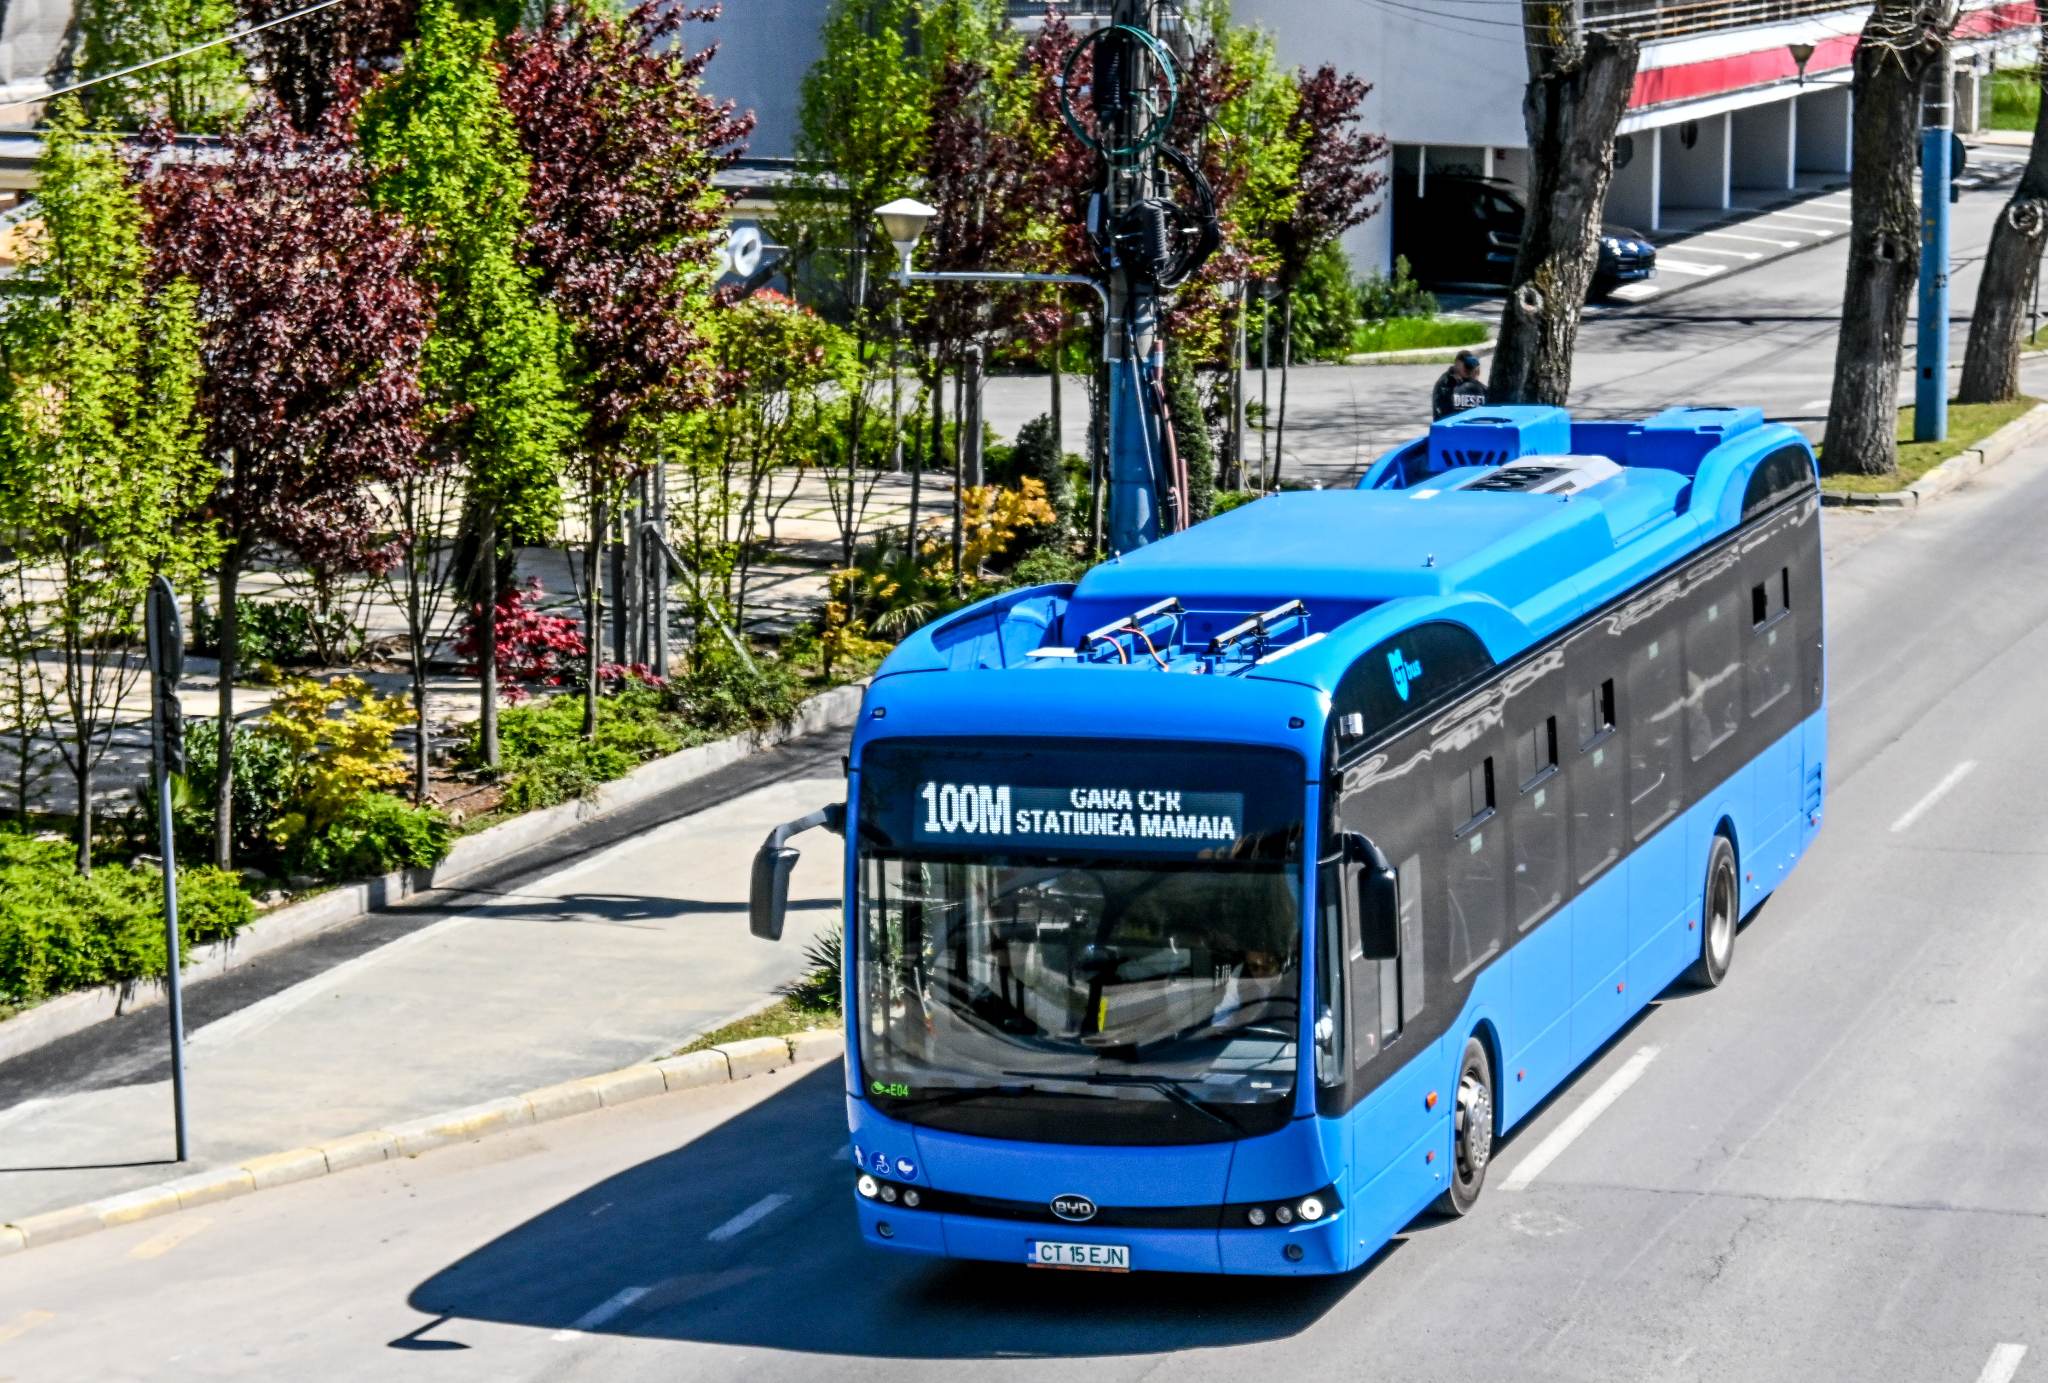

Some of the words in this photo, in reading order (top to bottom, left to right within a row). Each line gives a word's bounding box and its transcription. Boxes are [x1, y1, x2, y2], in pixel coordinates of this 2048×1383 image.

[922, 781, 1012, 835] 100M
[1016, 809, 1135, 837] STATIUNEA
[1140, 814, 1236, 840] MAMAIA
[890, 1083, 909, 1097] E04
[1055, 1201, 1091, 1215] BYD
[1041, 1245, 1063, 1261] CT
[1069, 1245, 1085, 1263] 15
[1090, 1247, 1124, 1265] EJN
